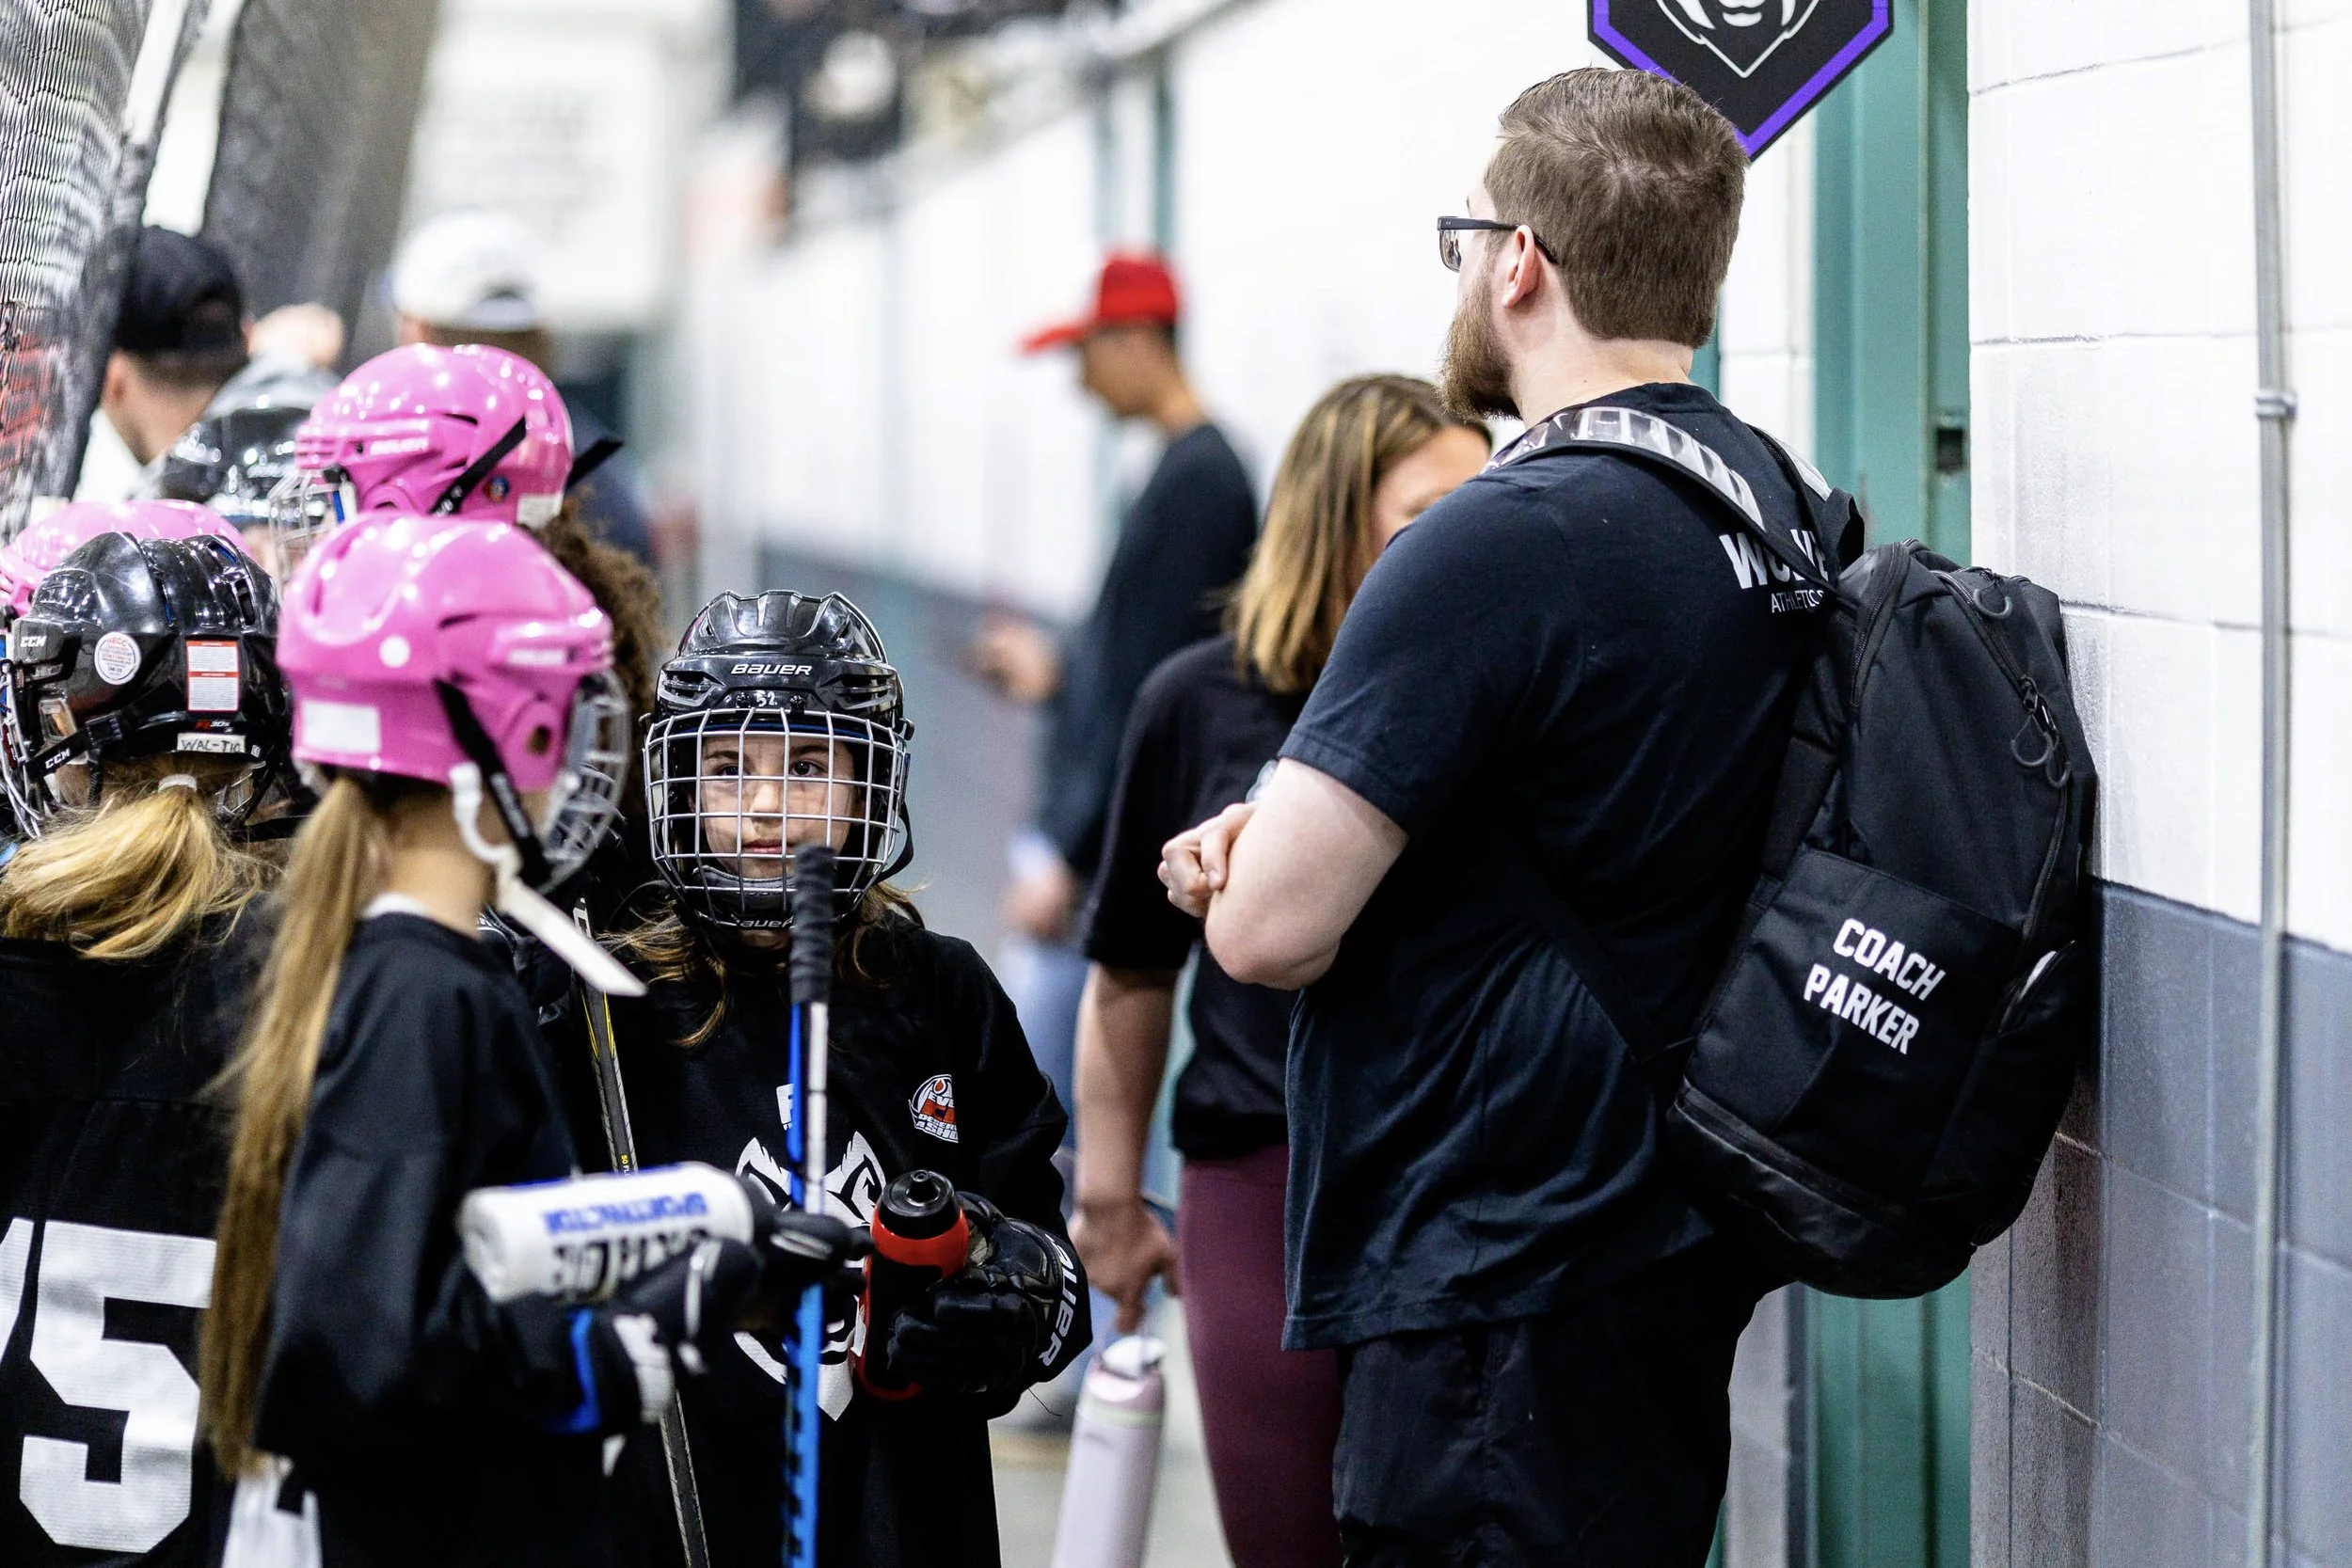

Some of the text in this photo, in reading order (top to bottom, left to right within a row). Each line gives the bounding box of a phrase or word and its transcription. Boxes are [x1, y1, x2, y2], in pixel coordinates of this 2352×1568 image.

[20, 636, 47, 647] CCM
[731, 663, 813, 675] BAUER
[44, 748, 71, 769] CCM
[738, 917, 794, 928] AUER
[1834, 918, 1946, 1002] COACH
[1804, 963, 1919, 1055] PARKER
[1038, 1233, 1078, 1367] AUER
